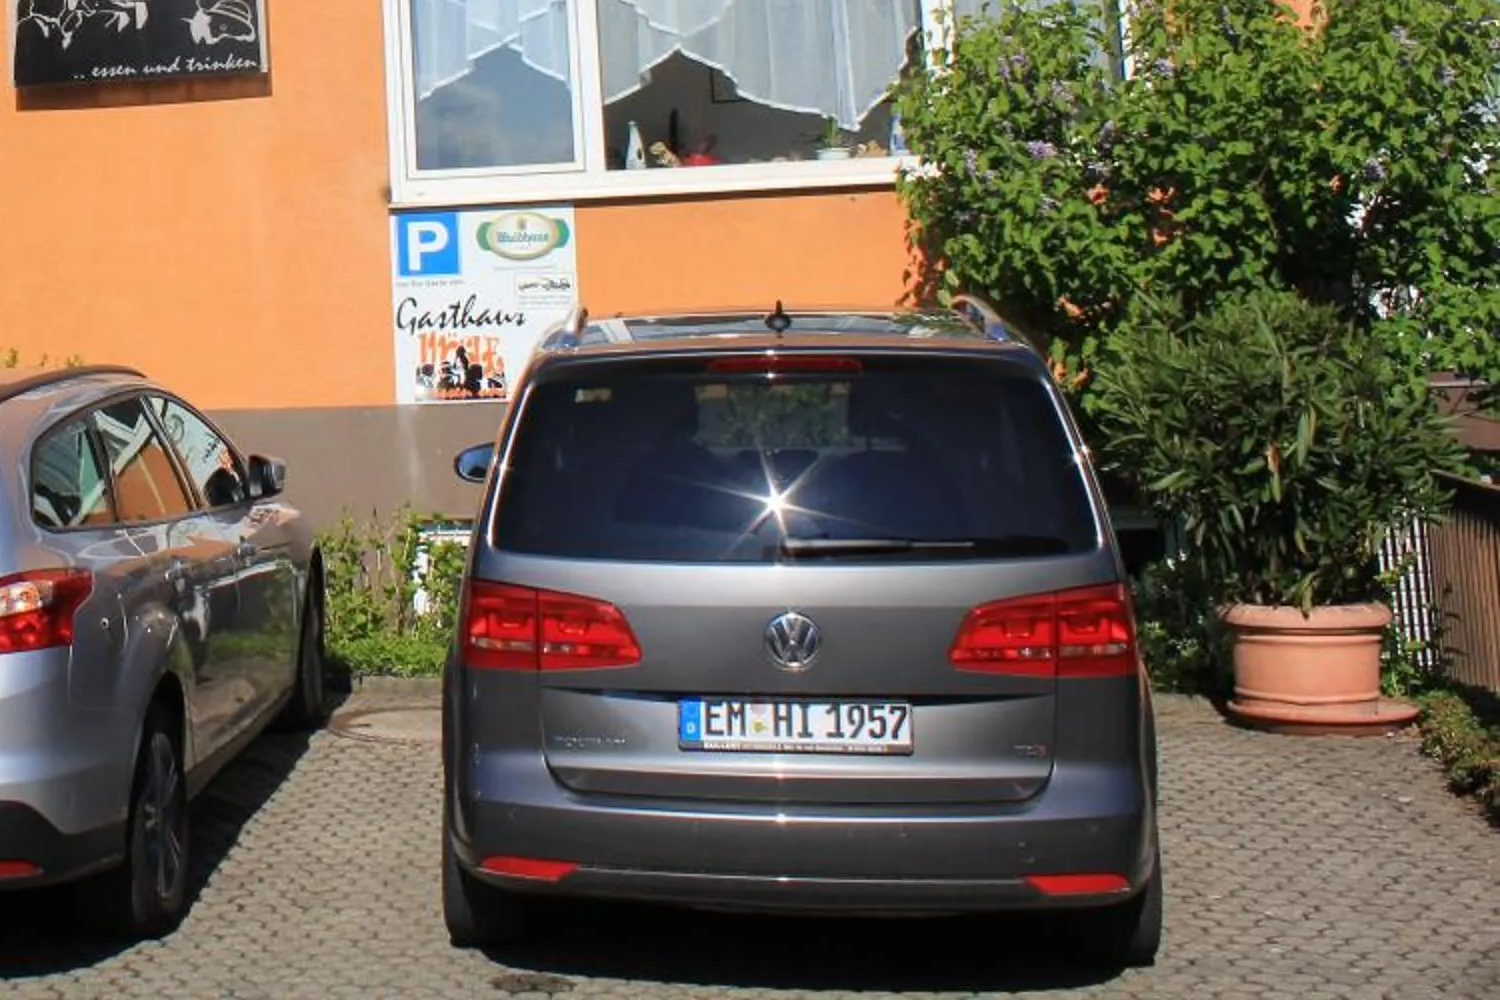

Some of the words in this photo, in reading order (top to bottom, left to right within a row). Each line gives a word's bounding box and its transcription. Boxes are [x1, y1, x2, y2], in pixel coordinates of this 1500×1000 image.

[91, 64, 137, 78] essen
[142, 56, 181, 73] und
[185, 53, 257, 72] trinken
[406, 220, 449, 271] P
[396, 293, 527, 335] Gasthaus
[704, 701, 746, 738] EM
[773, 702, 814, 739] HI
[825, 704, 908, 740] 1957
